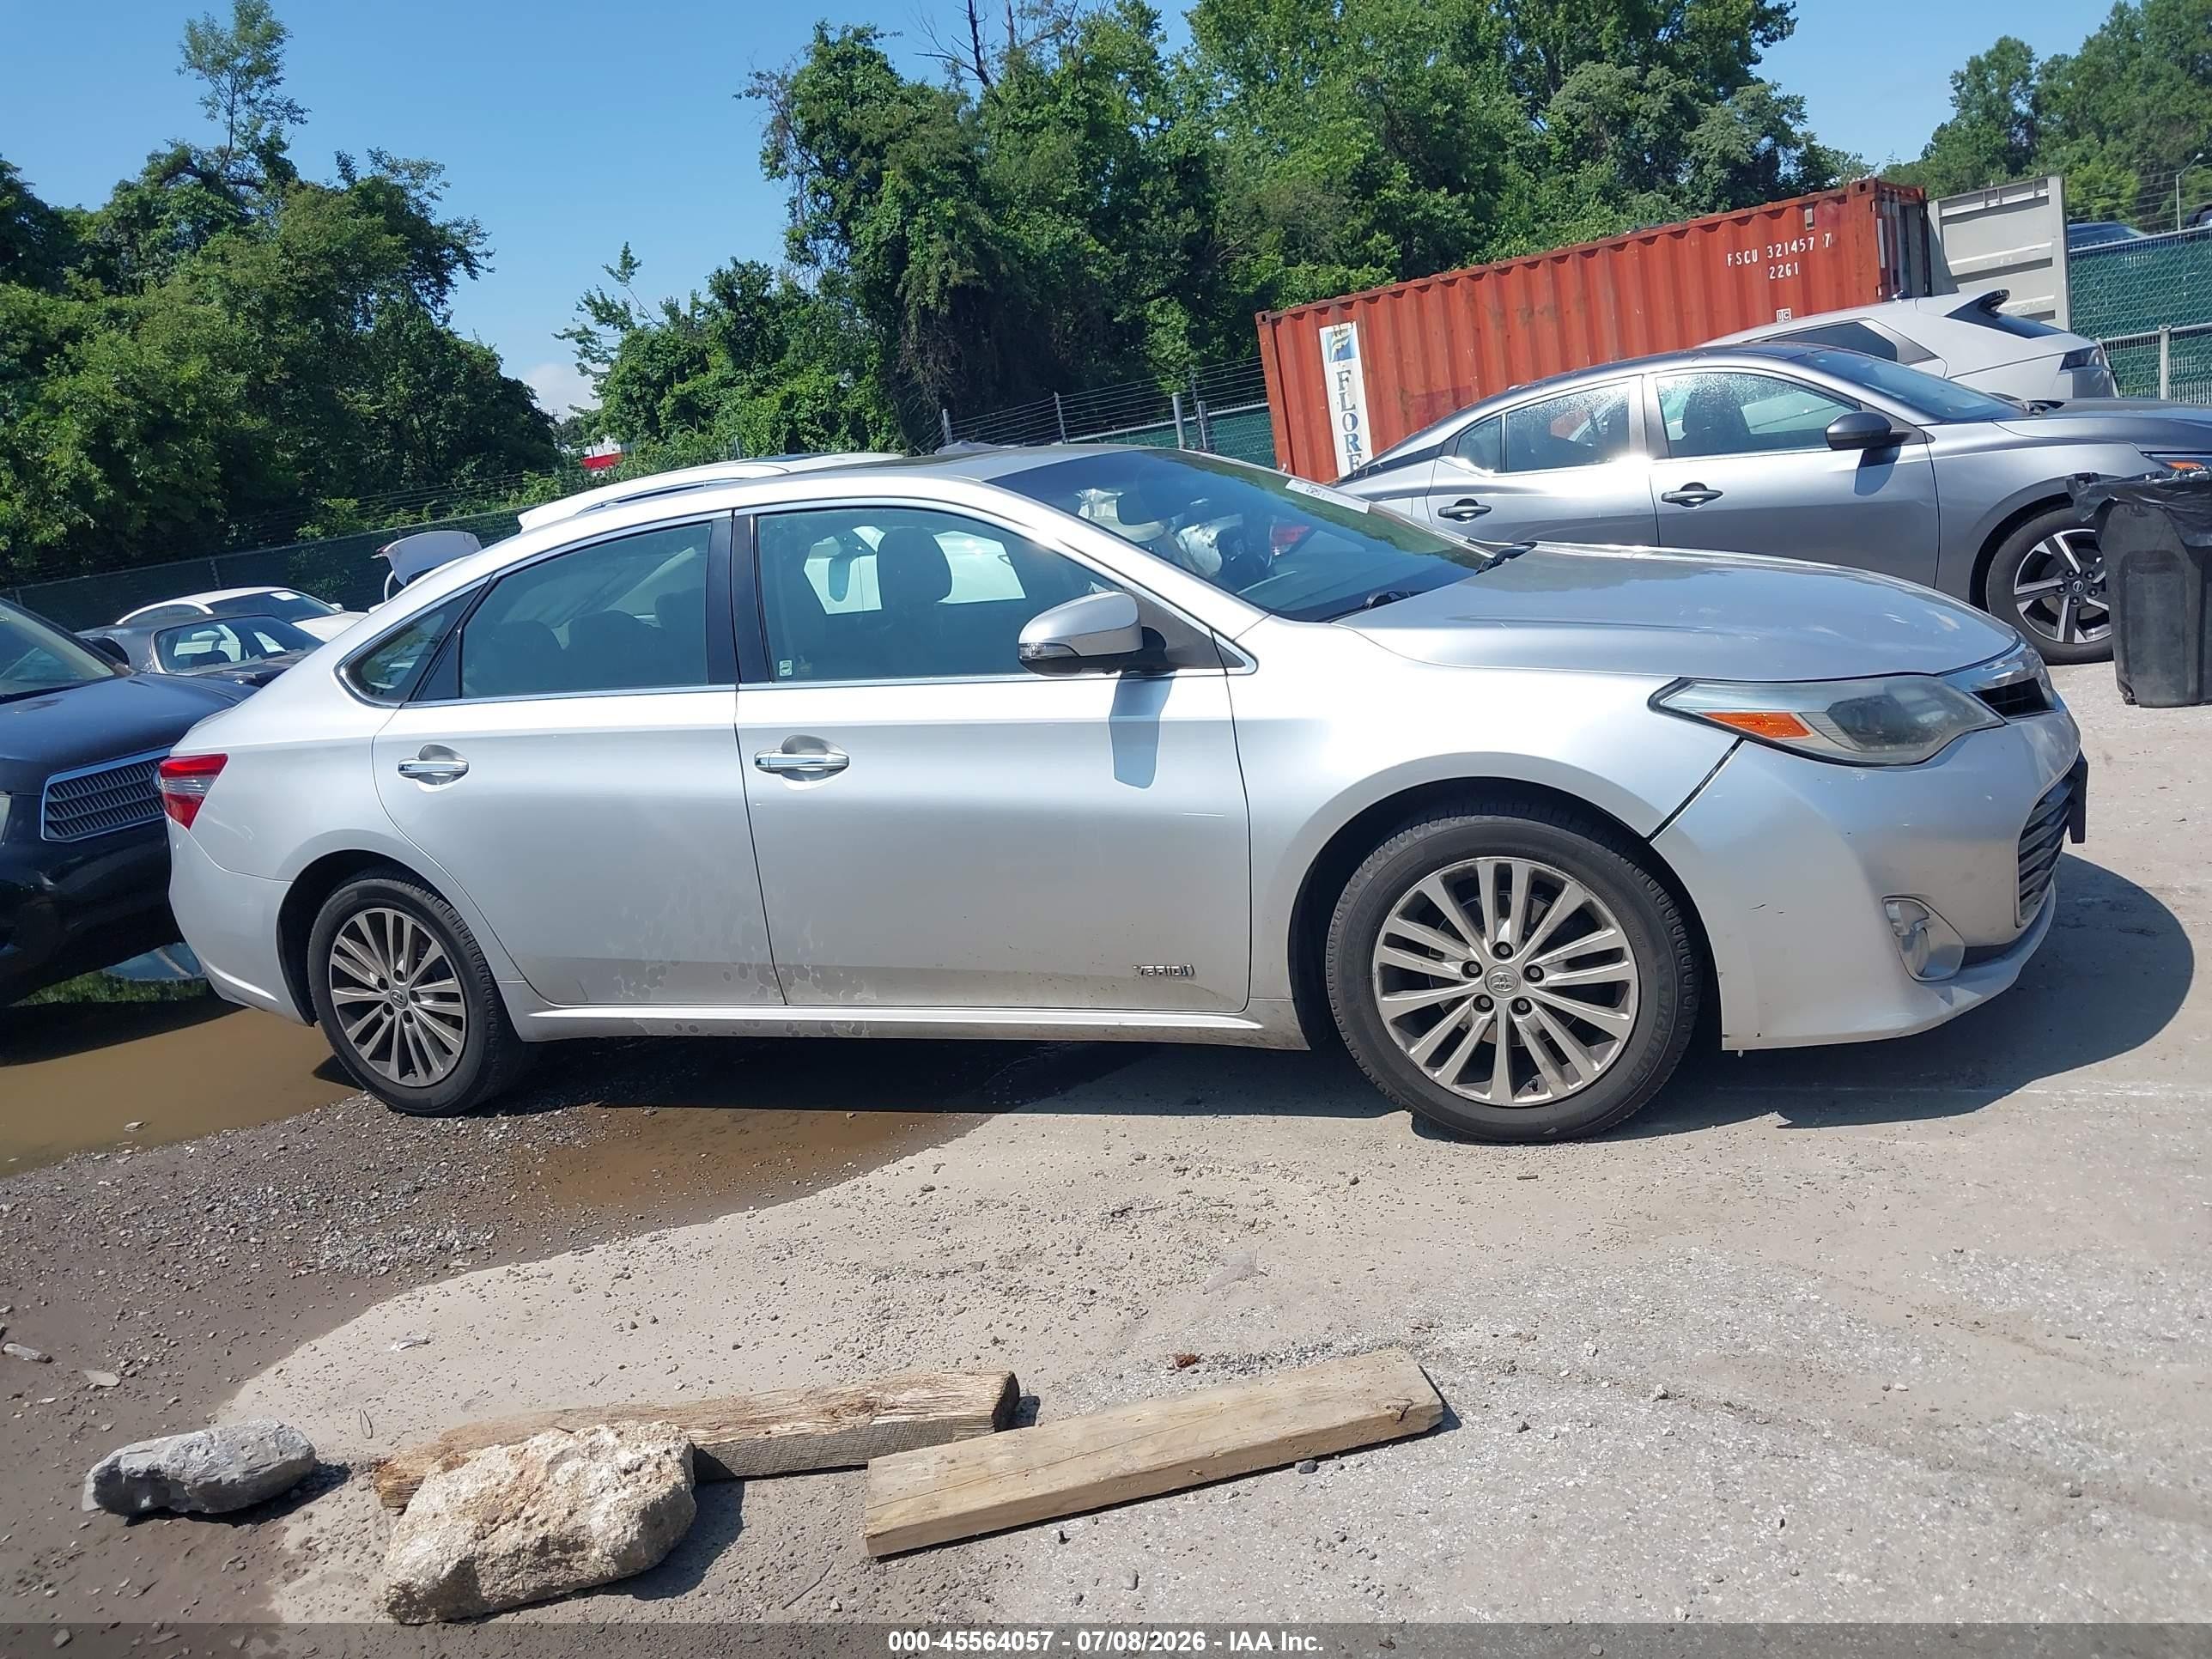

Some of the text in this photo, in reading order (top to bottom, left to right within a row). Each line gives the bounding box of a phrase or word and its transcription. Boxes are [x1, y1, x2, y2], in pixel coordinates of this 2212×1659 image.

[1727, 232, 1832, 267] FSCU 321457 7
[1769, 261, 1799, 280] 22G1
